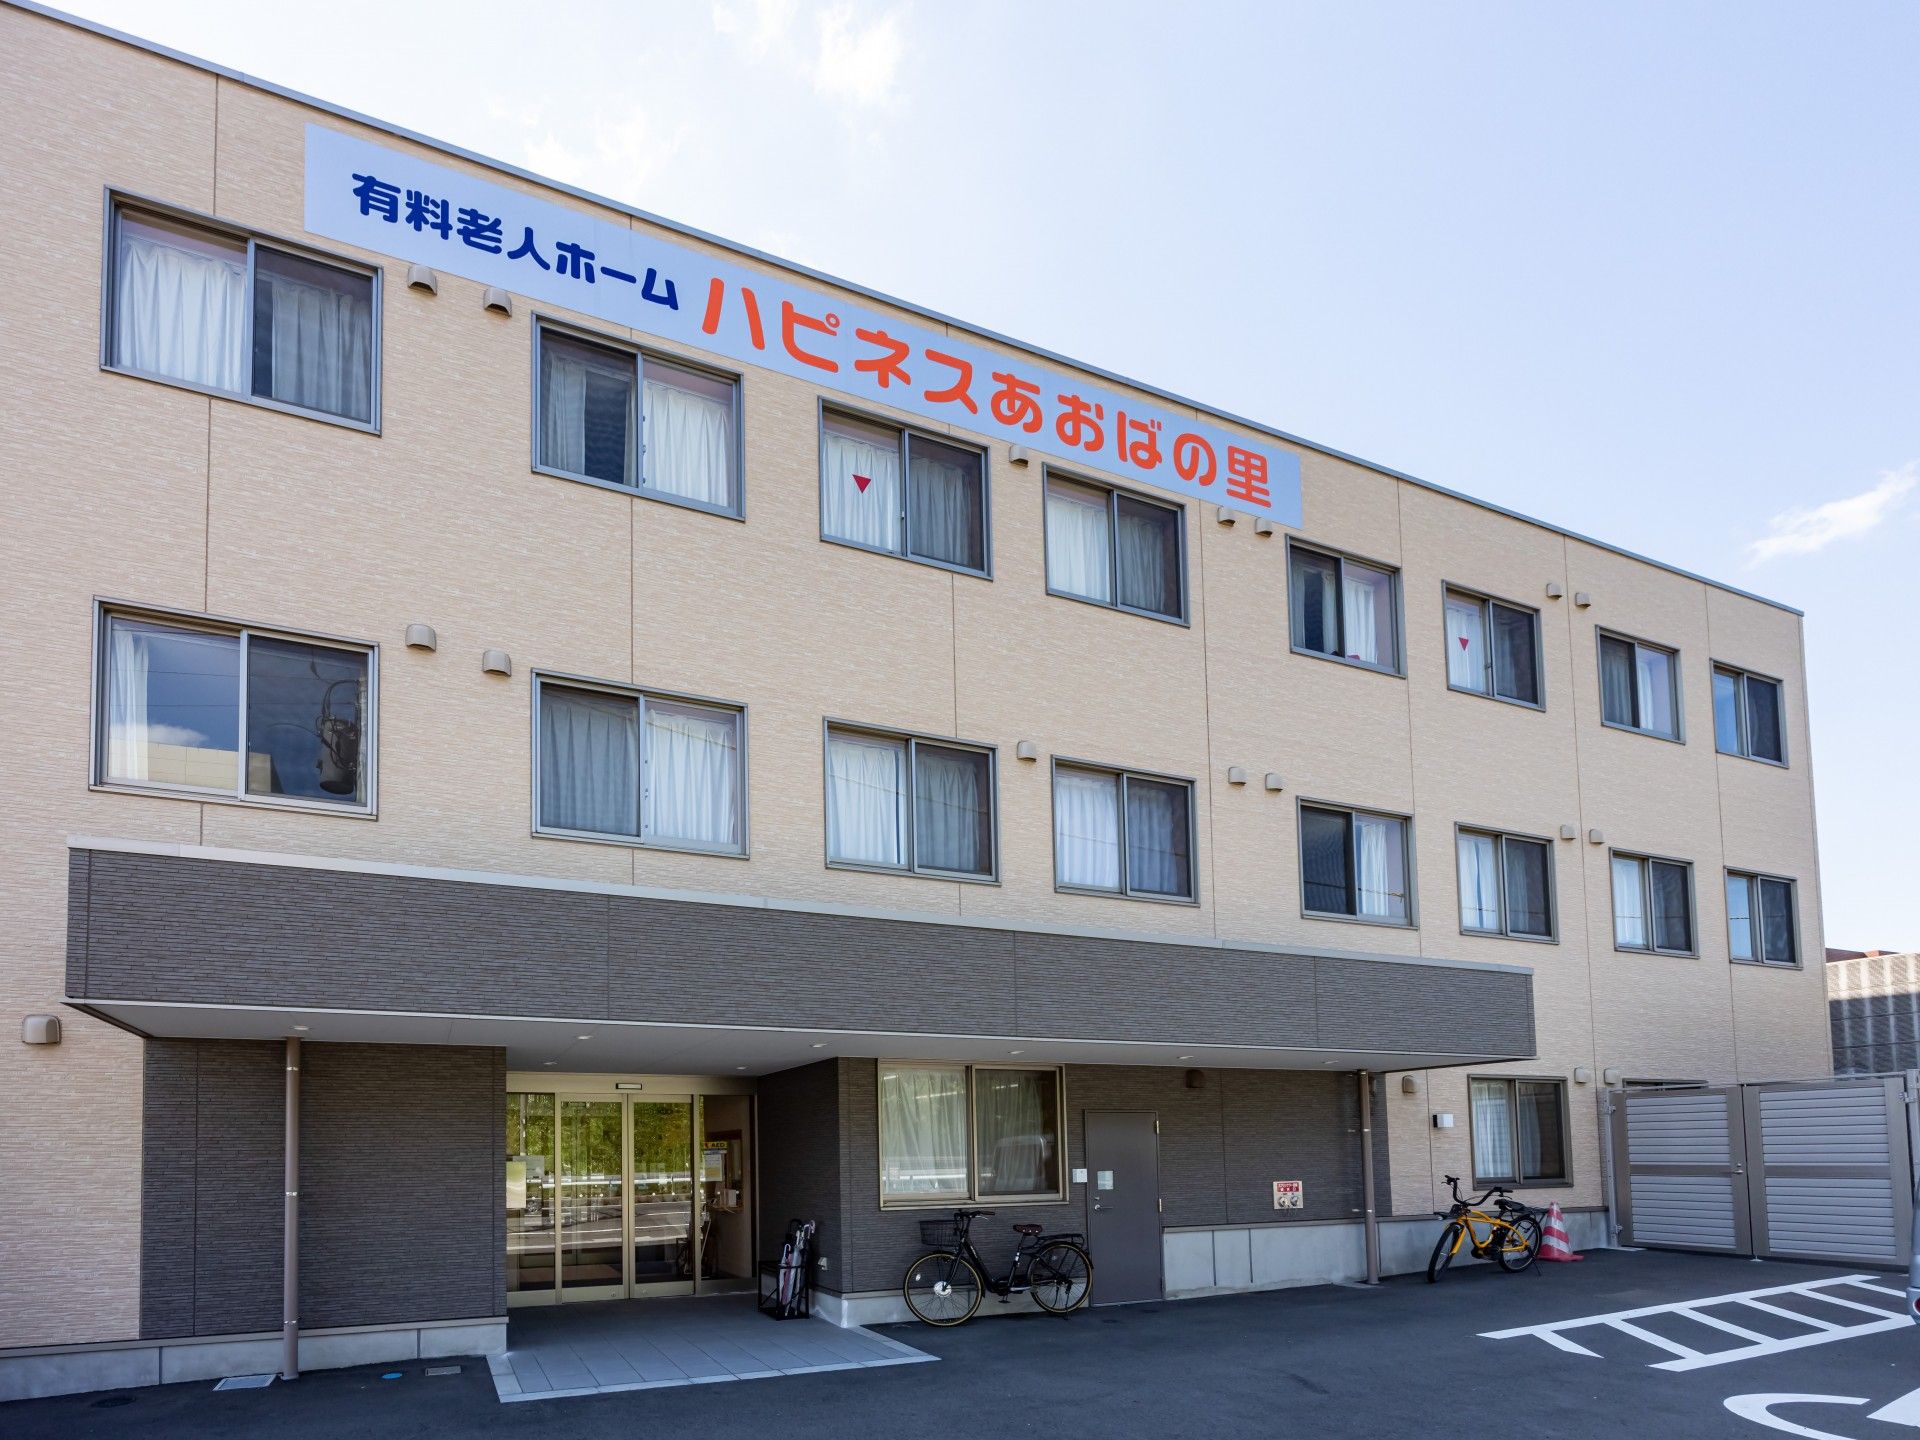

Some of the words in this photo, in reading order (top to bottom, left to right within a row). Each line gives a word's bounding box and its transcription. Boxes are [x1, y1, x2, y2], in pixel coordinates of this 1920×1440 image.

[351, 173, 679, 311] 有料老人ホーム
[702, 278, 1271, 507] ハピネスあおばの里
